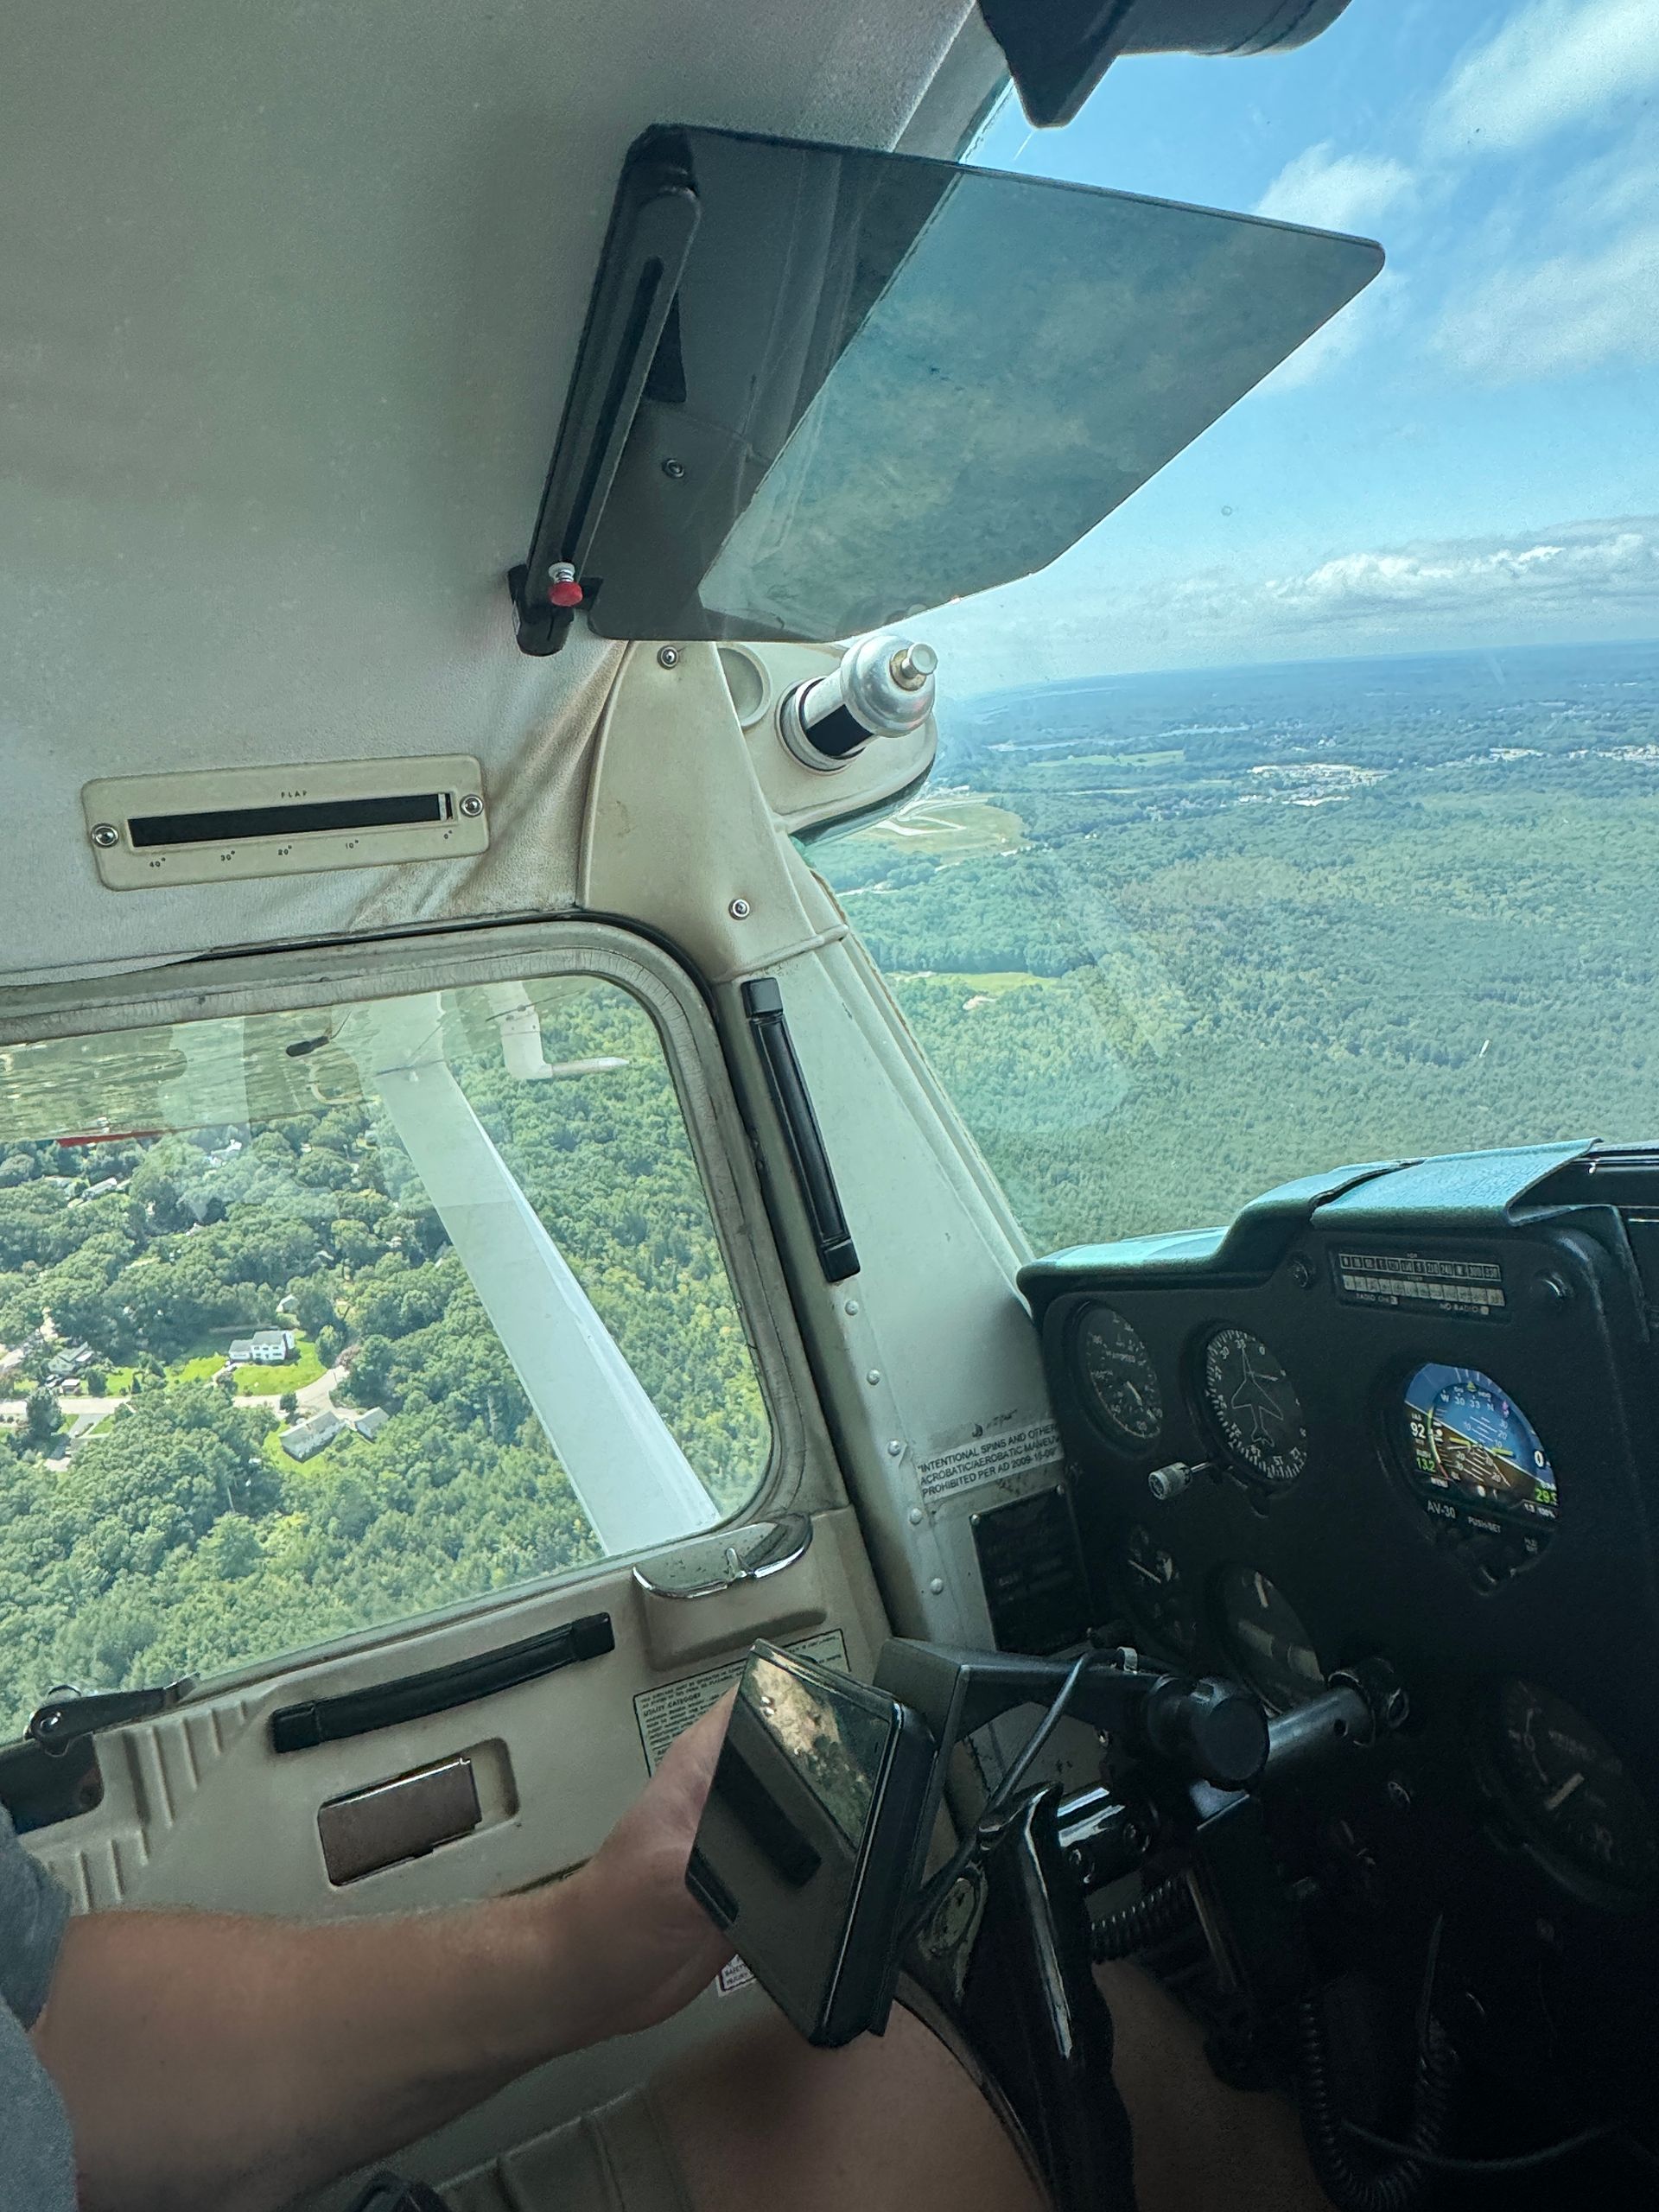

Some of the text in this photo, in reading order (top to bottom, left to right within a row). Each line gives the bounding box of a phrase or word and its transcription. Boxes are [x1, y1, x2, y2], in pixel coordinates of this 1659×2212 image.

[1469, 1399, 1481, 1409] 33
[1410, 1421, 1426, 1439] 92
[981, 1438, 1007, 1455] SPINS
[1008, 1431, 1027, 1446] AND
[922, 1472, 976, 1496] PROHIBITED
[977, 1465, 996, 1480] PER
[997, 1460, 1010, 1474] AD
[1427, 1499, 1457, 1519] AV-30
[668, 1692, 701, 1708] CATEGORY
